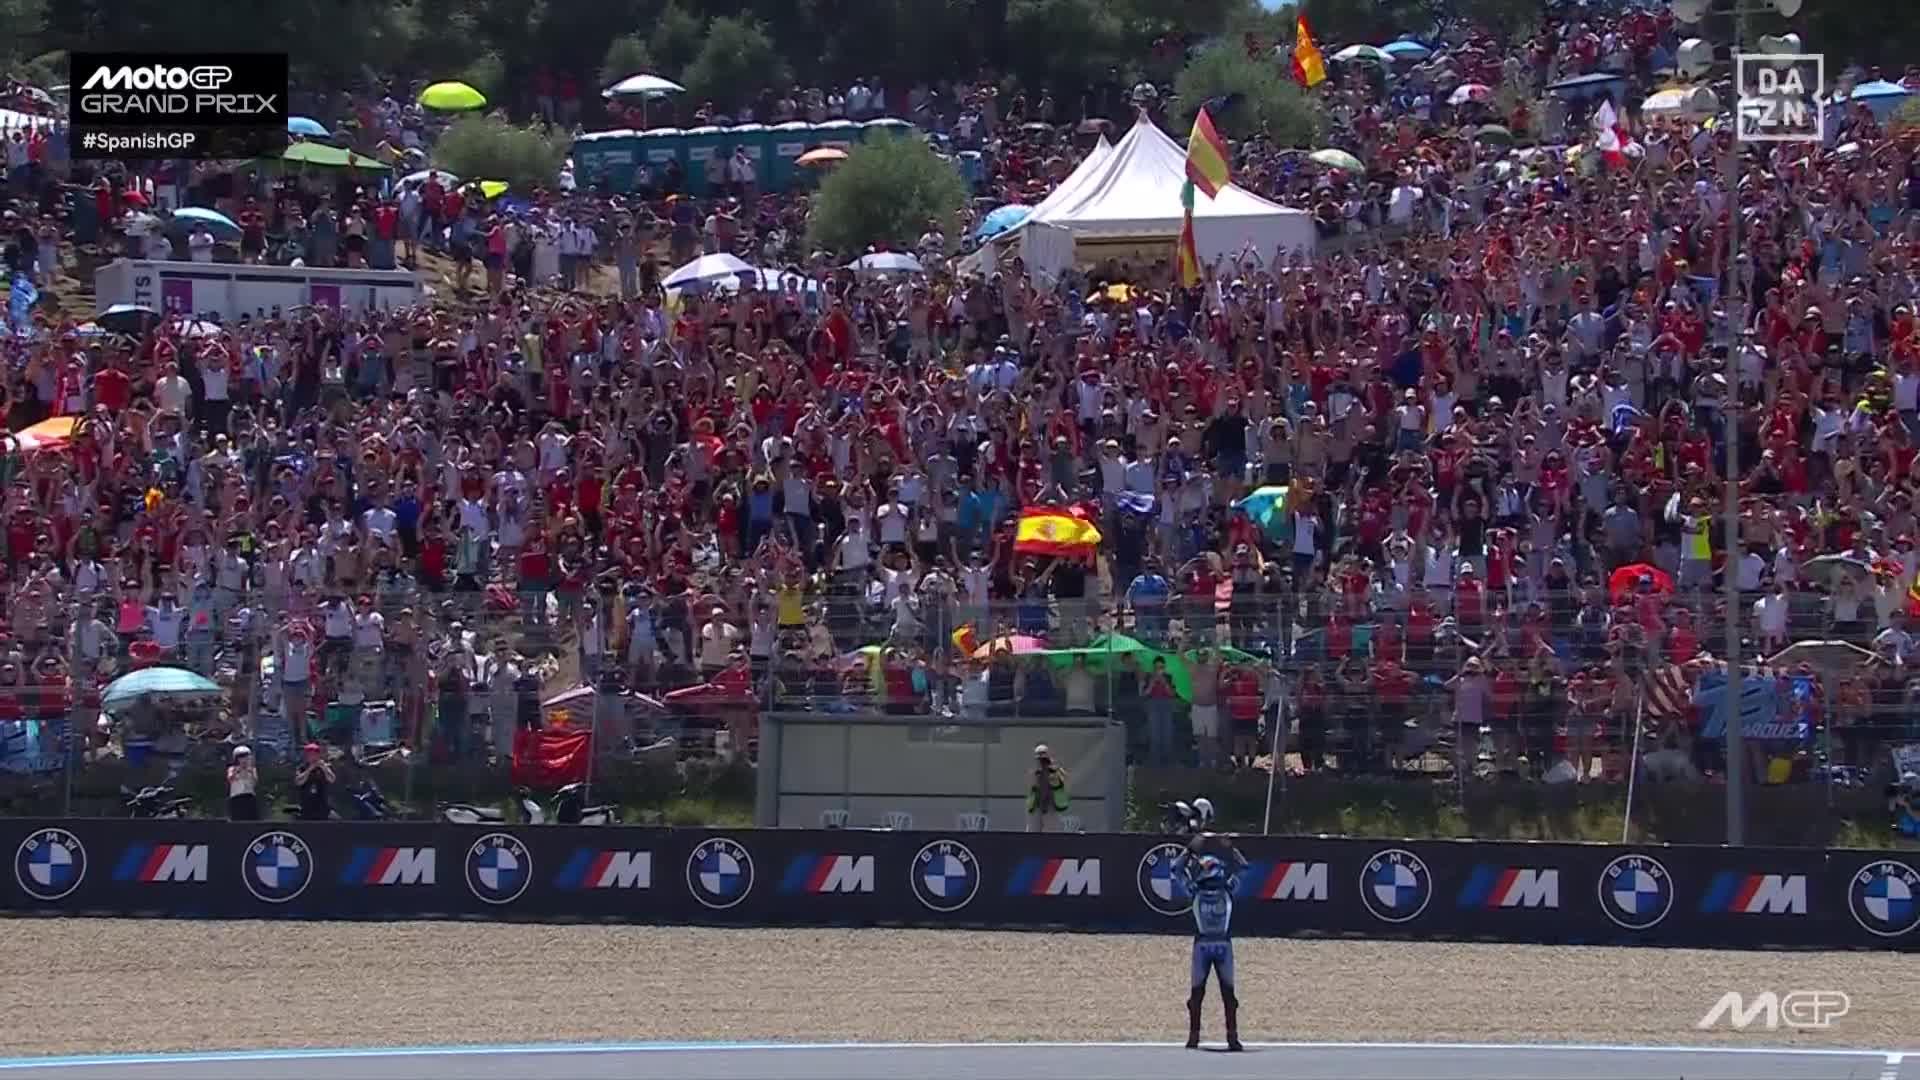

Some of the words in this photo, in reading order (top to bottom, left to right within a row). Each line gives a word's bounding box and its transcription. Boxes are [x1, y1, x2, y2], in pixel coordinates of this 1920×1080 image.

[25, 832, 77, 851] BMW
[253, 835, 303, 854] BMW
[474, 837, 521, 856] BMW
[696, 842, 744, 861] BMW
[921, 843, 970, 863] BMW
[1370, 853, 1421, 873] BMW
[1608, 859, 1663, 879] BMW
[1860, 864, 1916, 885] BMW
